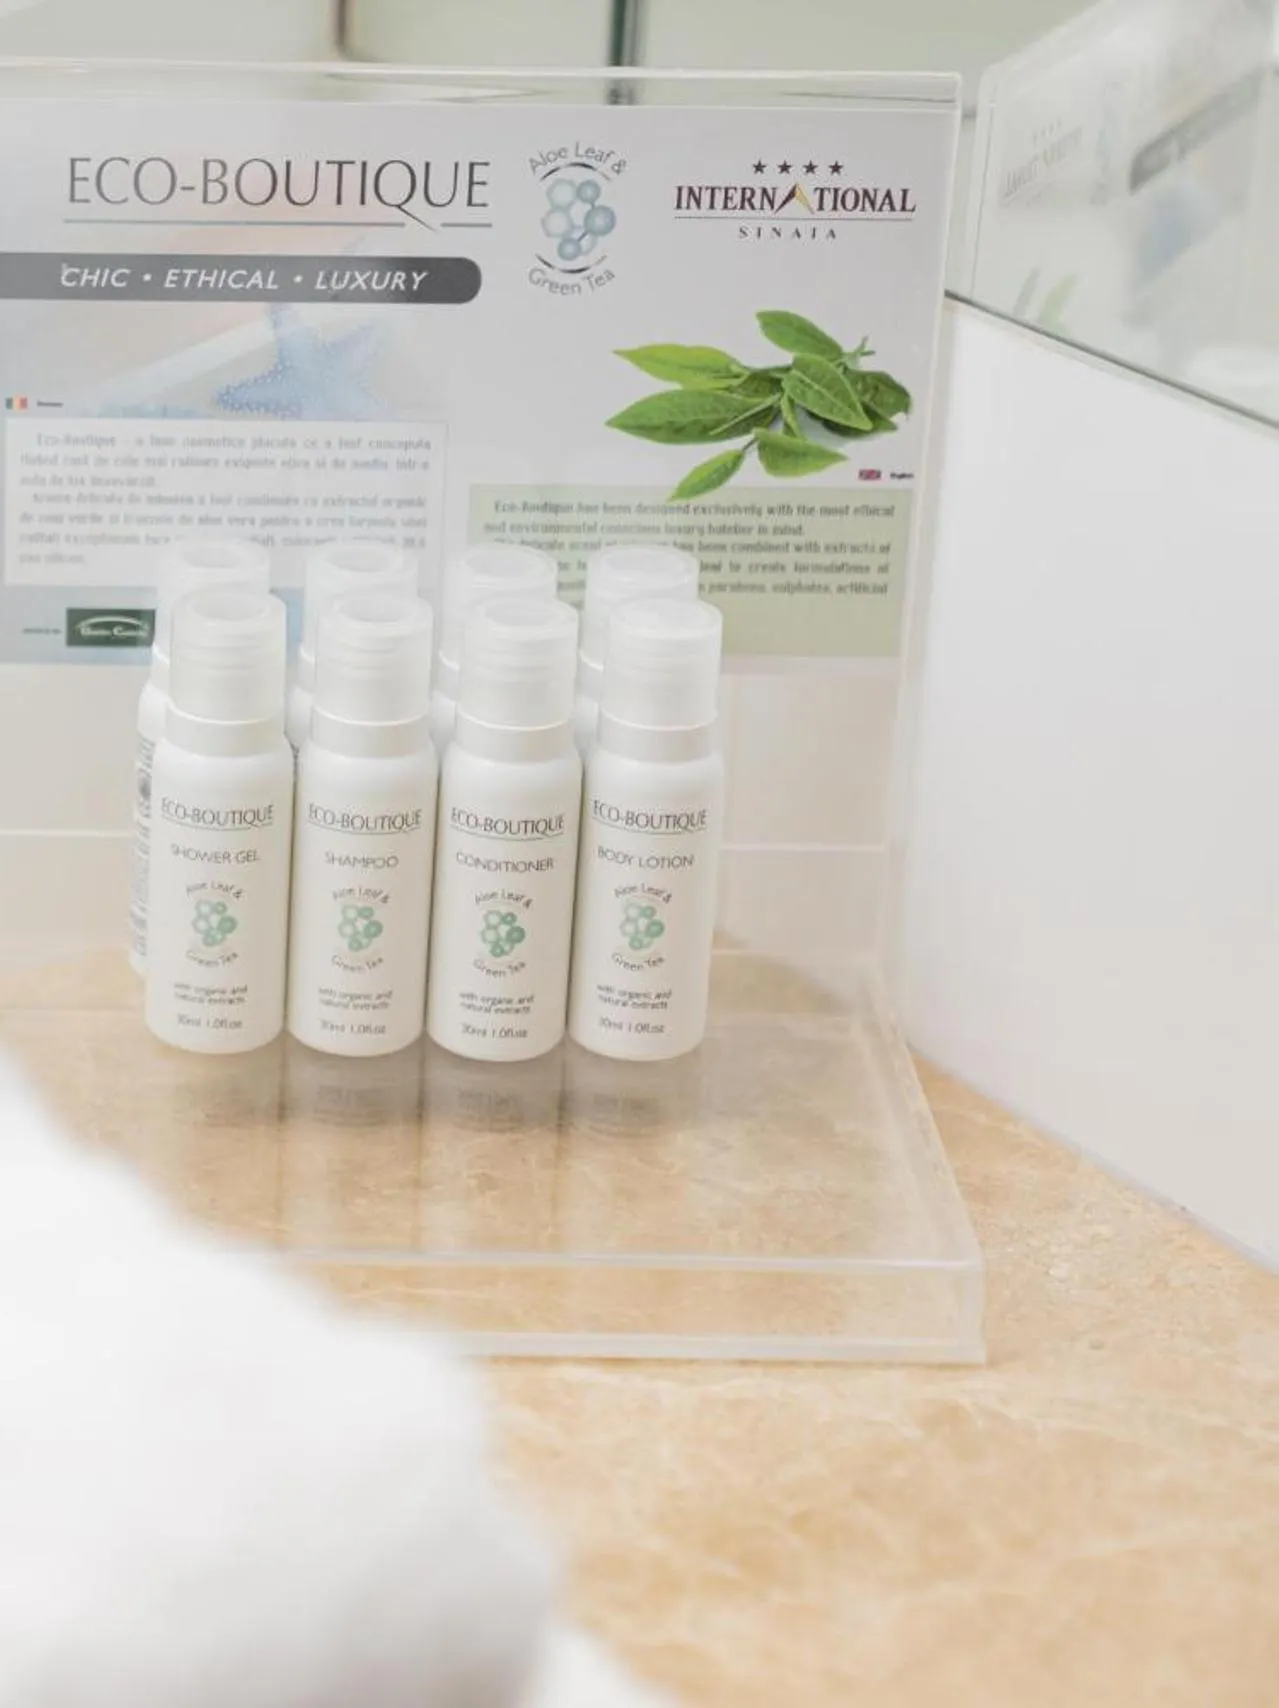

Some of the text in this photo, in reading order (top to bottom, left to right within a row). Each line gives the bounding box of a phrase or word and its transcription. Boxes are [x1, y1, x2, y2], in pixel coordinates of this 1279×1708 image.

[528, 141, 627, 176] Aloe Leaf &
[68, 156, 491, 231] ECO-BOUTIQUE
[674, 182, 917, 214] INTERNATIONAL
[738, 226, 838, 239] SINAIA
[60, 265, 429, 292] CHIC ETHICAL LUXURY
[528, 267, 616, 296] Green Tea
[161, 797, 275, 828] ECO-BOUTIQUE
[308, 803, 423, 832] ECO-BOUTIQUE
[451, 806, 565, 837] ECO-BOUTIQUE
[592, 799, 707, 832] ECO-BOUTIQUE
[170, 843, 261, 864] SHOWER GEL
[324, 851, 399, 870] SHAMPOO
[456, 851, 554, 873] CONDITIONER
[596, 845, 695, 870] BODY LOTION
